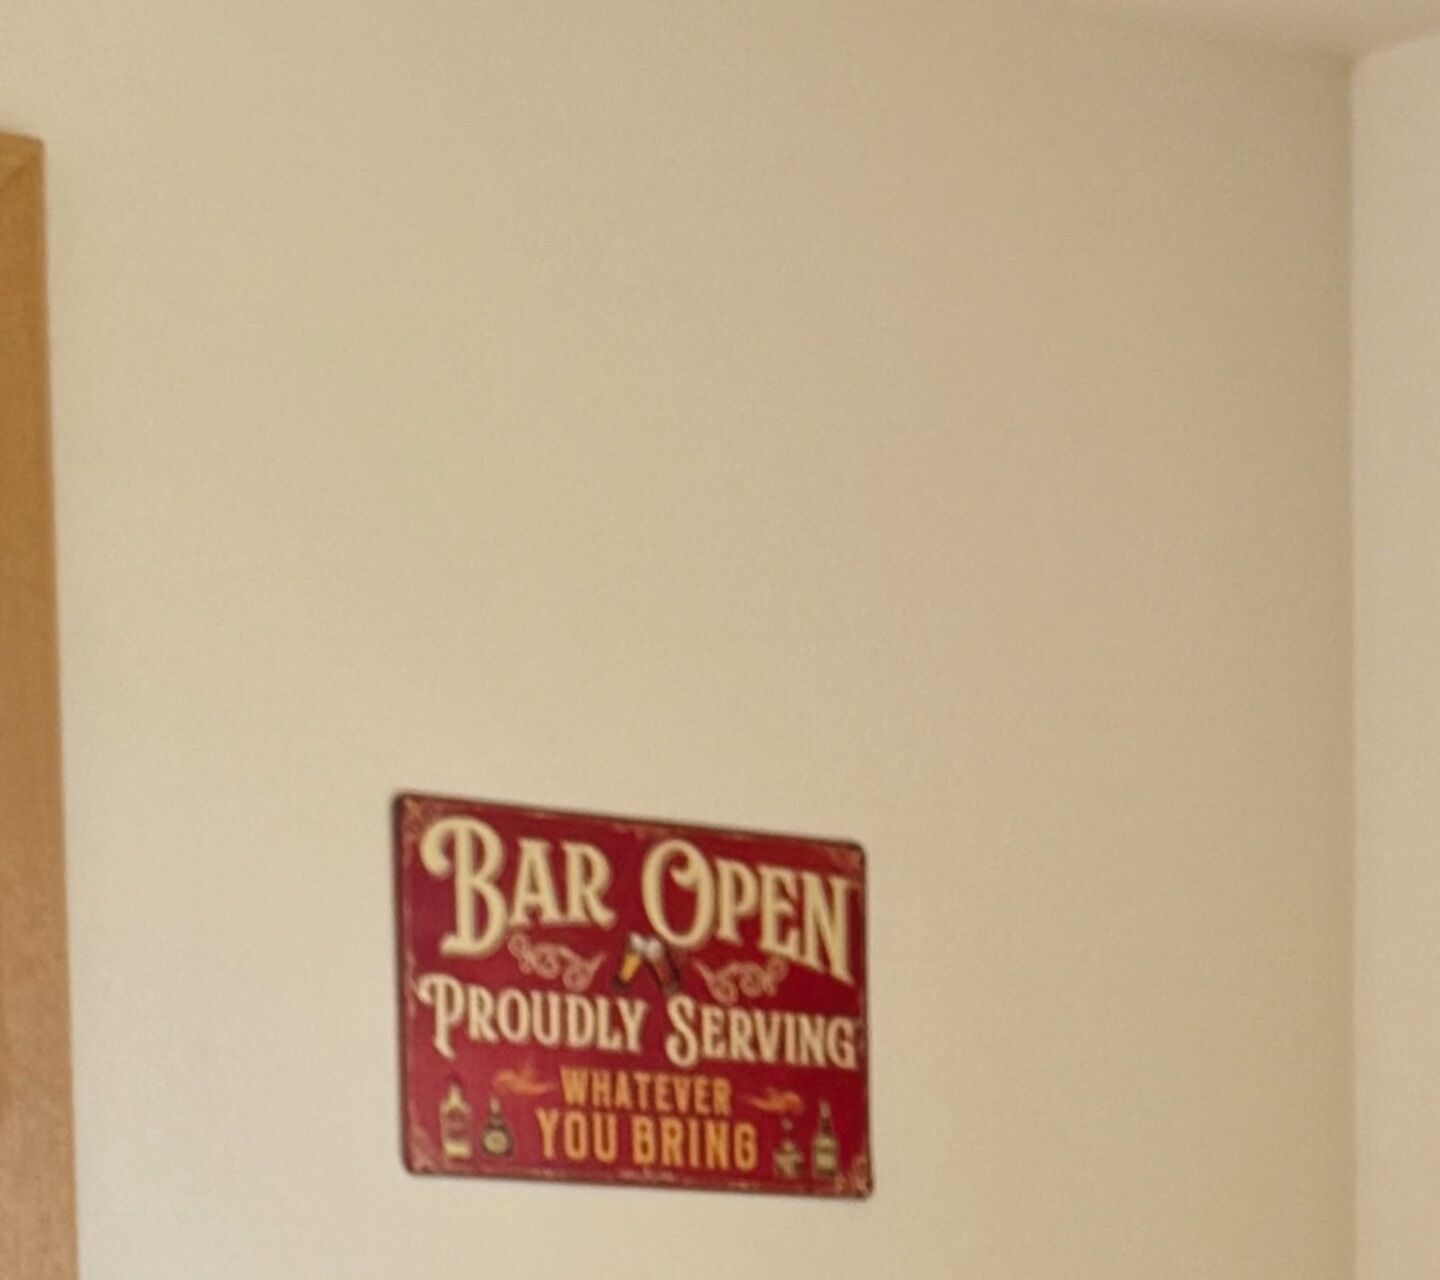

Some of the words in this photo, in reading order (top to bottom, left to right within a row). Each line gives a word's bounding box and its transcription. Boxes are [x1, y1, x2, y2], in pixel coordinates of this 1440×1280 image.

[419, 815, 618, 957] BAR
[641, 839, 855, 987] OPEN
[417, 972, 648, 1059] PROUDLY
[665, 994, 859, 1071] SERVING
[559, 1066, 733, 1115] WHATEVER
[535, 1108, 619, 1162] YOU
[630, 1113, 759, 1171] BRING
